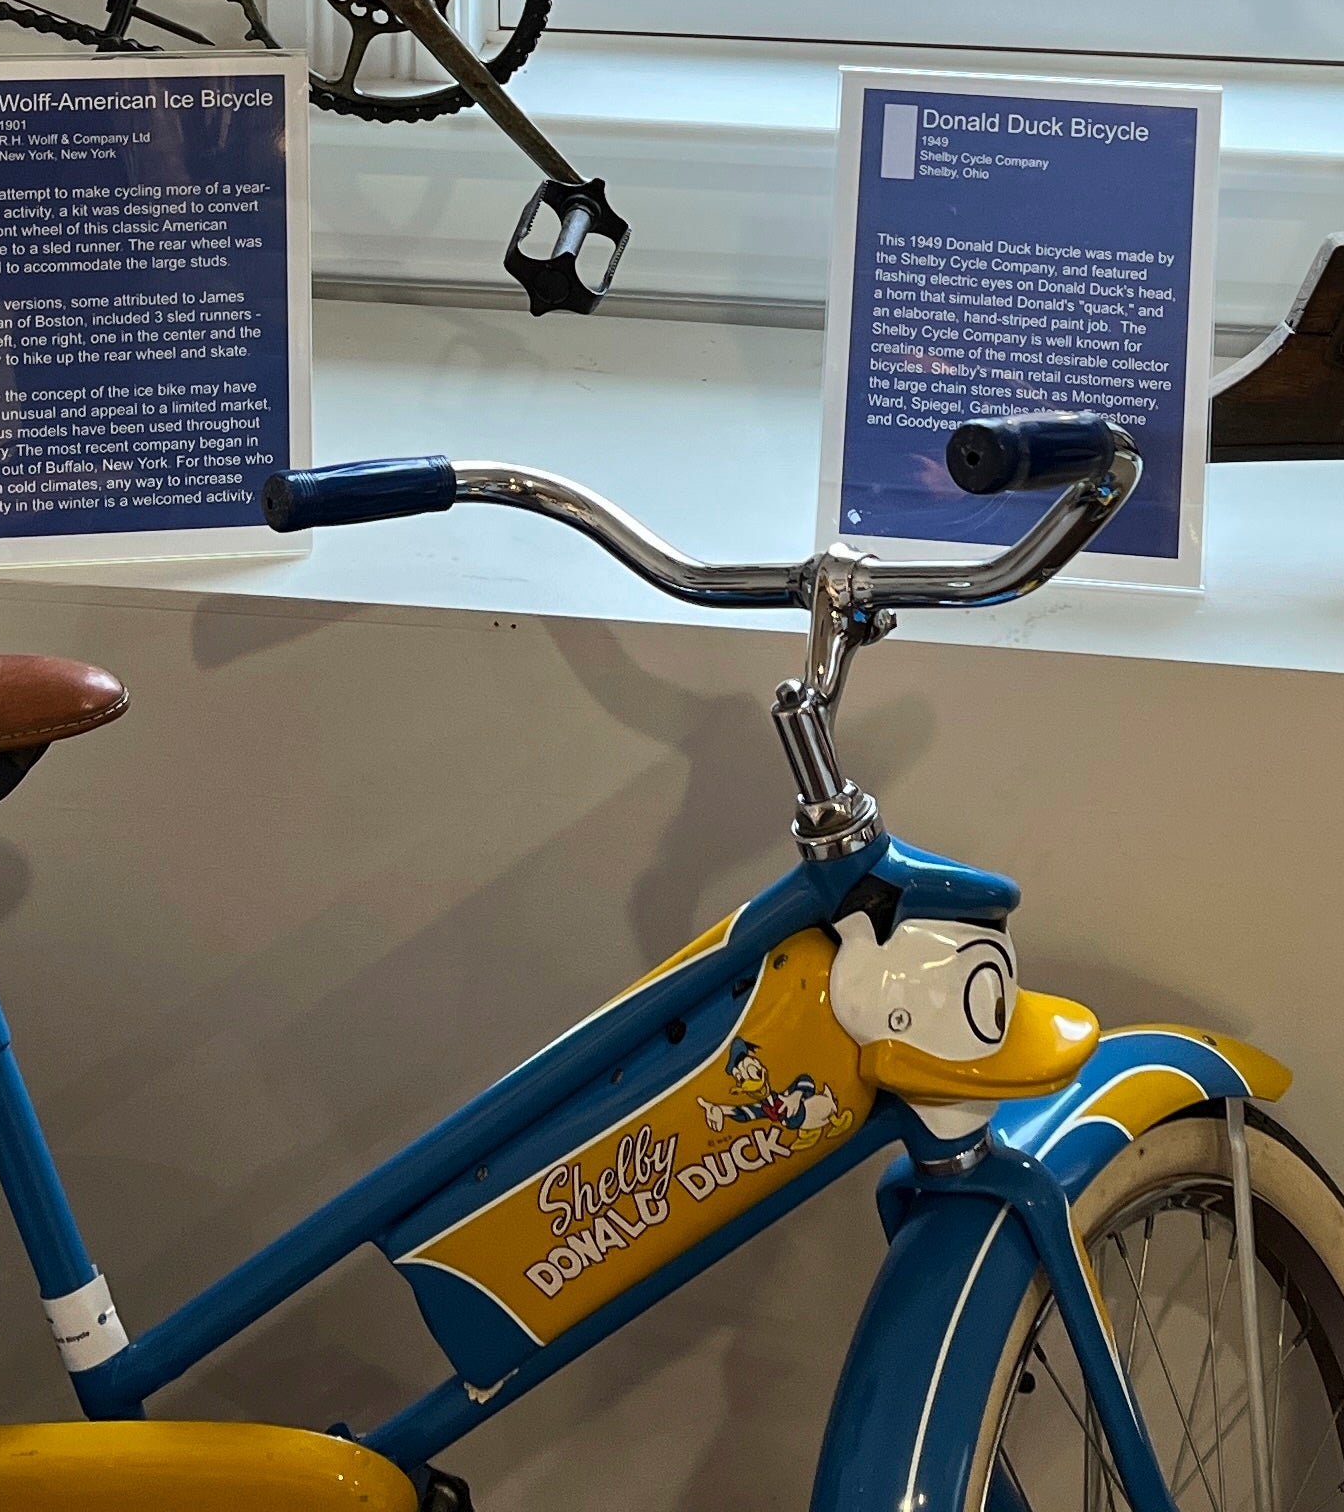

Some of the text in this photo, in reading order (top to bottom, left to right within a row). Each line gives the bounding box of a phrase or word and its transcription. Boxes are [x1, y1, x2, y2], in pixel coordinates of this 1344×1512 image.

[164, 92, 195, 109] Ice
[201, 90, 273, 112] Bicycle
[0, 119, 26, 131] 1901
[922, 110, 1149, 143] Donald Duck Bicycle
[27, 133, 59, 146] Wolff
[60, 133, 70, 145] &
[72, 133, 130, 146] Company
[132, 131, 151, 143] Ltd
[921, 135, 949, 148] 1949
[27, 149, 58, 161] York,
[60, 148, 88, 160] New
[90, 148, 117, 159] York
[919, 149, 1050, 171] Shelby Cycle Company
[918, 164, 990, 180] Shelby, Ohio
[54, 186, 69, 199] to
[71, 185, 111, 199] make
[114, 184, 162, 201] cycling
[165, 185, 202, 196] more
[204, 181, 219, 195] of
[222, 184, 232, 195] a
[234, 183, 271, 197] year-
[3, 204, 55, 221] activity,
[58, 207, 68, 218] a
[72, 203, 89, 217] kit
[91, 205, 120, 216] was
[123, 200, 187, 218] designed
[190, 201, 205, 214] to
[207, 199, 259, 213] convert
[20, 222, 63, 237] wheel
[66, 221, 81, 236] of
[83, 221, 109, 235] this
[112, 219, 160, 234] classic
[161, 218, 228, 232] American
[11, 242, 26, 256] to
[29, 244, 39, 255] a
[42, 240, 71, 255] sled
[75, 241, 124, 253] runner.
[127, 238, 155, 252] The
[158, 239, 187, 251] rear
[190, 235, 231, 250] wheel
[234, 237, 263, 248] was
[877, 232, 1175, 268] This 1949 Donald Duck bicycle was made by
[5, 261, 20, 274] to
[23, 257, 122, 274] accommodate
[125, 256, 148, 270] the
[151, 256, 187, 272] large
[190, 254, 231, 268] studs.
[876, 251, 1148, 281] the Shelby Cycle Company, and featured
[874, 268, 1176, 303] flashing electric eyes on Donald Duck's head,
[873, 286, 1164, 318] a horn that simulated Donald's "quack," and
[866, 412, 893, 426] and
[867, 393, 908, 411] Ward,
[910, 396, 965, 415] Spiegel,
[969, 400, 1029, 416] Gambles
[1083, 409, 1147, 426] restone
[538, 1124, 678, 1236] Shelby
[524, 1126, 792, 1299] DONALD DUCK
